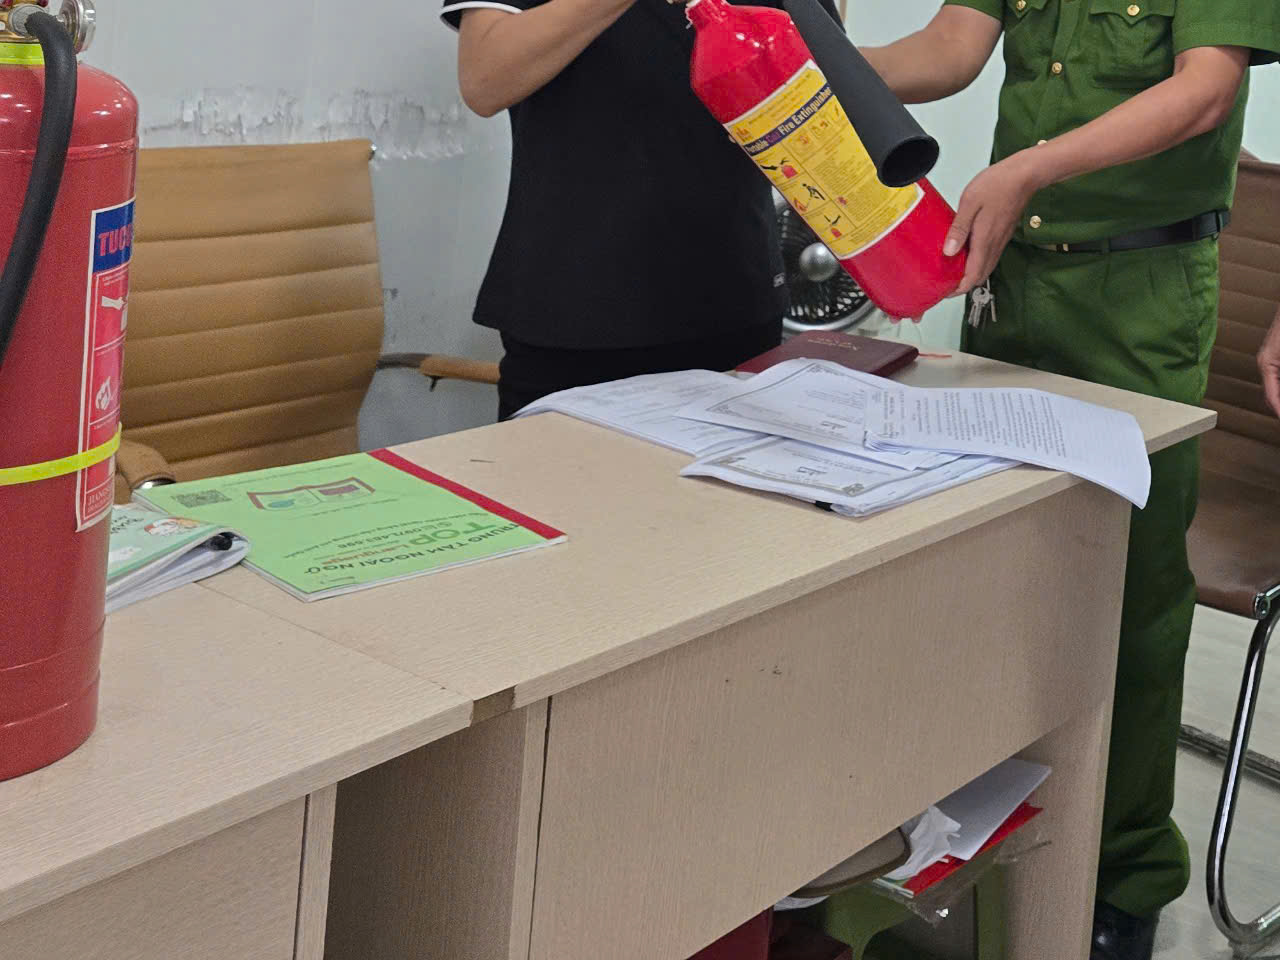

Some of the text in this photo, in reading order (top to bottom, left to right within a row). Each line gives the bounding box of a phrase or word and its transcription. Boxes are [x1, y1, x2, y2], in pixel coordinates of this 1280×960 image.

[777, 121, 796, 136] Fire
[791, 87, 832, 126] Extinguisher
[408, 522, 497, 545] TOP
[468, 523, 519, 542] TRUNG
[321, 543, 409, 565] Language
[426, 541, 469, 554] TÂM
